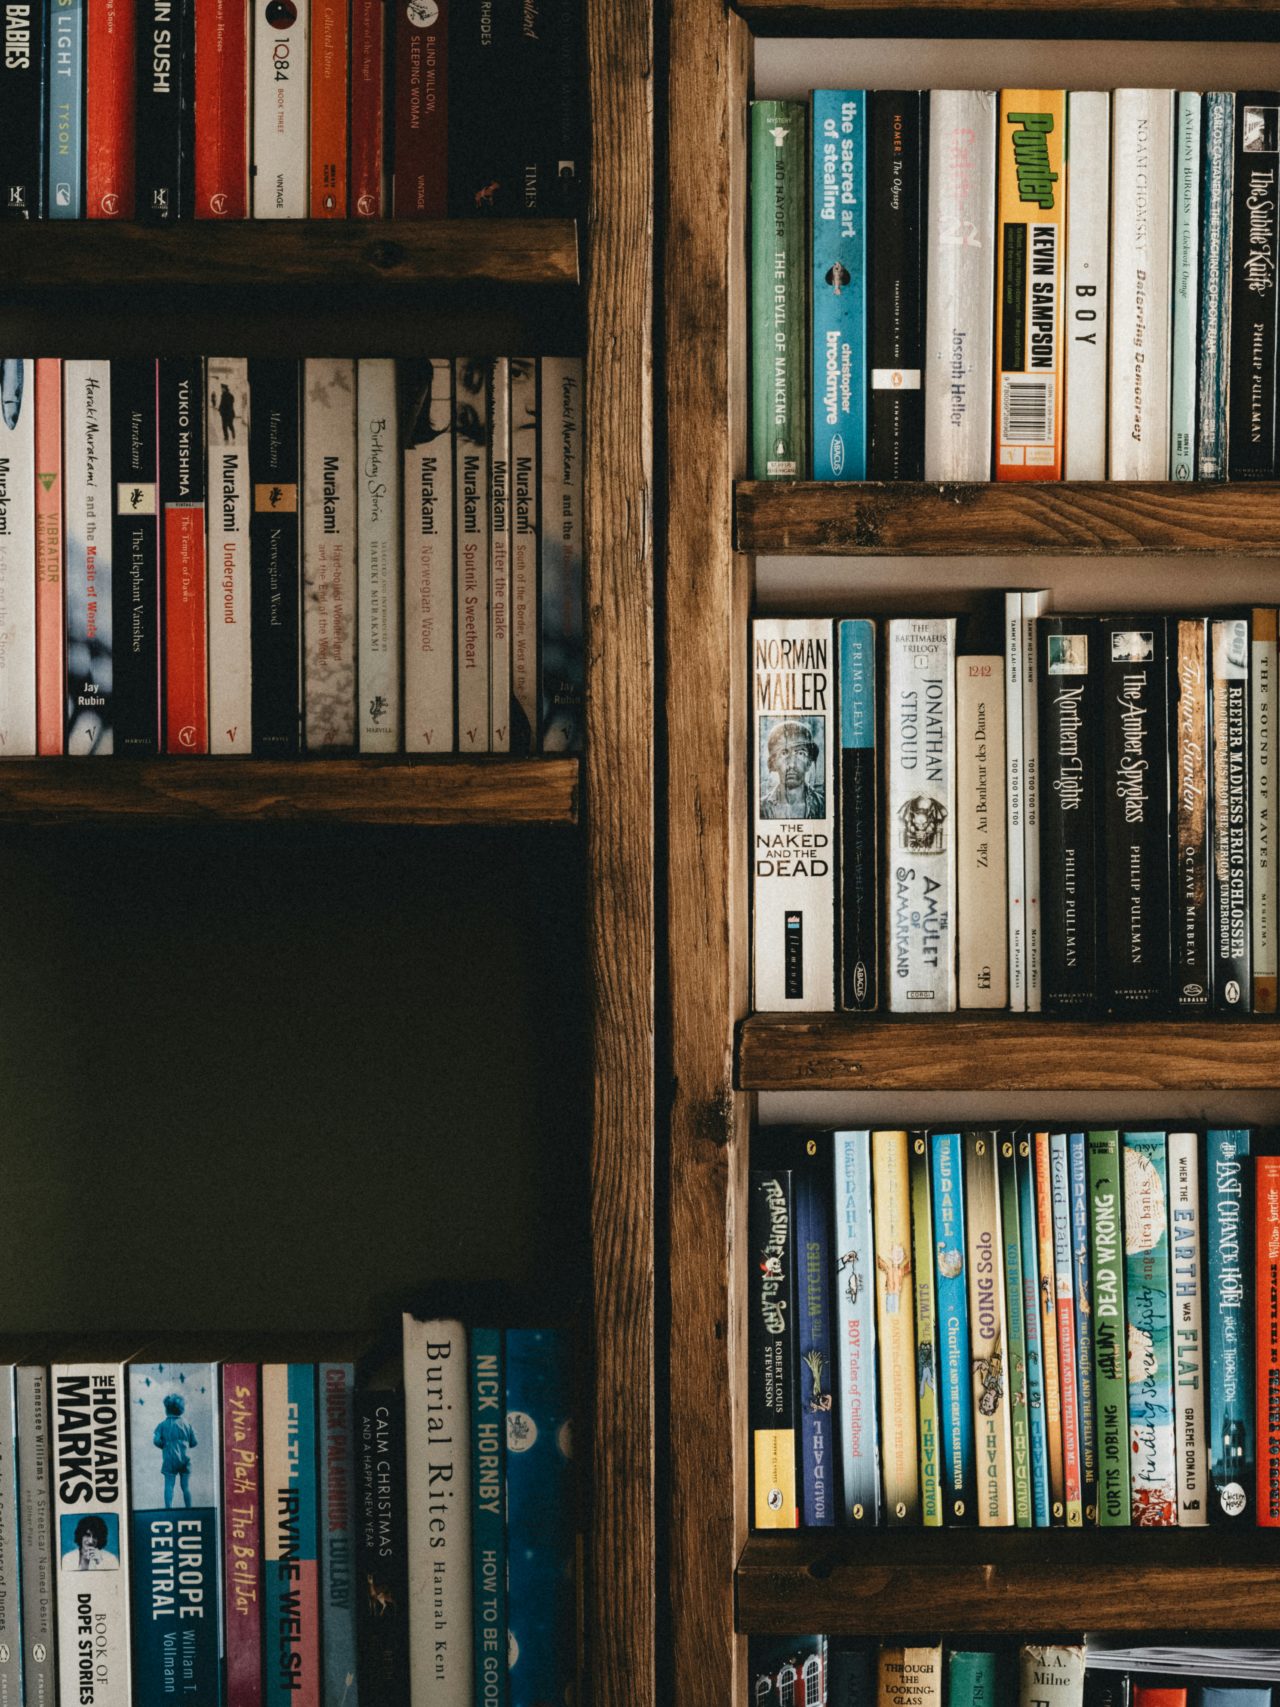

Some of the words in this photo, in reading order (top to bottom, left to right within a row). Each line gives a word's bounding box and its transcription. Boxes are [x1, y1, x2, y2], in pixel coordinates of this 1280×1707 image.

[5, 5, 30, 68] BABIES
[58, 16, 71, 76] LIGHT
[273, 37, 289, 81] 1Q84
[153, 30, 170, 92] SUSHI
[59, 103, 69, 155] TYSON
[824, 119, 837, 138] of
[841, 102, 856, 132] the
[821, 144, 838, 219] stealing
[841, 139, 856, 204] sacred
[1008, 113, 1058, 209] Powder
[1251, 169, 1273, 196] The
[841, 210, 856, 237] art
[1250, 200, 1273, 244] Subtle
[775, 251, 785, 280] THE
[1034, 227, 1053, 275] KEVIN
[1244, 246, 1274, 296] Knife
[775, 285, 785, 328] DEVIL
[1032, 283, 1053, 367] SAMPSON
[775, 333, 785, 352] OF
[1253, 324, 1264, 370] PHILIP
[775, 357, 785, 424] NANKING
[824, 331, 839, 424] brookmyre
[839, 343, 852, 412] christopher
[178, 380, 190, 426] YUKIO
[1251, 374, 1263, 442] PULLMAN
[179, 433, 191, 495] MISHIMA
[223, 454, 238, 532] Murakami
[132, 529, 143, 550] The
[130, 554, 144, 602] Elephant
[223, 543, 237, 624] Underground
[132, 605, 143, 652] Vanishes
[756, 640, 827, 669] NORMAN
[756, 673, 827, 710] MAILER
[1124, 671, 1146, 697] The
[1057, 686, 1084, 755] Northern
[1118, 699, 1147, 754] Amber
[1229, 688, 1243, 747] REEFER
[1054, 758, 1084, 809] Lights
[1117, 756, 1148, 822] Spyglass
[1229, 752, 1243, 822] MADNESS
[757, 835, 828, 848] NAKED
[1230, 828, 1243, 863] ERIC
[757, 860, 828, 877] DEAD
[1231, 868, 1244, 959] SCHLOSSER
[1179, 1158, 1187, 1182] WHEN
[1179, 1185, 1188, 1201] THE
[1174, 1209, 1197, 1296] EARTH
[1183, 1303, 1191, 1321] WAS
[476, 1355, 498, 1411] NICK
[765, 1347, 773, 1407] STEVENSON
[1178, 1330, 1199, 1389] FLAT
[229, 1386, 252, 1441] Sylvia
[426, 1341, 451, 1445] Burial
[776, 1383, 784, 1413] LOUIS
[376, 1407, 389, 1453] CALM
[1185, 1408, 1194, 1447] GRAEME
[233, 1449, 255, 1493] Plath
[478, 1424, 499, 1515] HORNBY
[1186, 1451, 1195, 1490] DONALD
[233, 1505, 254, 1538] The
[377, 1461, 392, 1556] CHRISTMAS
[428, 1463, 453, 1548] Rites
[278, 1488, 300, 1580] IRVINE
[151, 1521, 174, 1620] CENTRAL
[178, 1521, 203, 1619] EUROPE
[232, 1546, 255, 1584] Bell
[482, 1551, 496, 1592] HOW
[235, 1587, 255, 1615] Jar
[483, 1600, 496, 1621] TO
[280, 1591, 302, 1690] WELSH
[484, 1628, 497, 1651] BE
[485, 1657, 498, 1707] GOOD
[885, 1663, 934, 1674] THROUGH
[886, 1685, 934, 1694] LOOKING-
[899, 1675, 919, 1684] THE
[893, 1696, 922, 1705] GLASS
